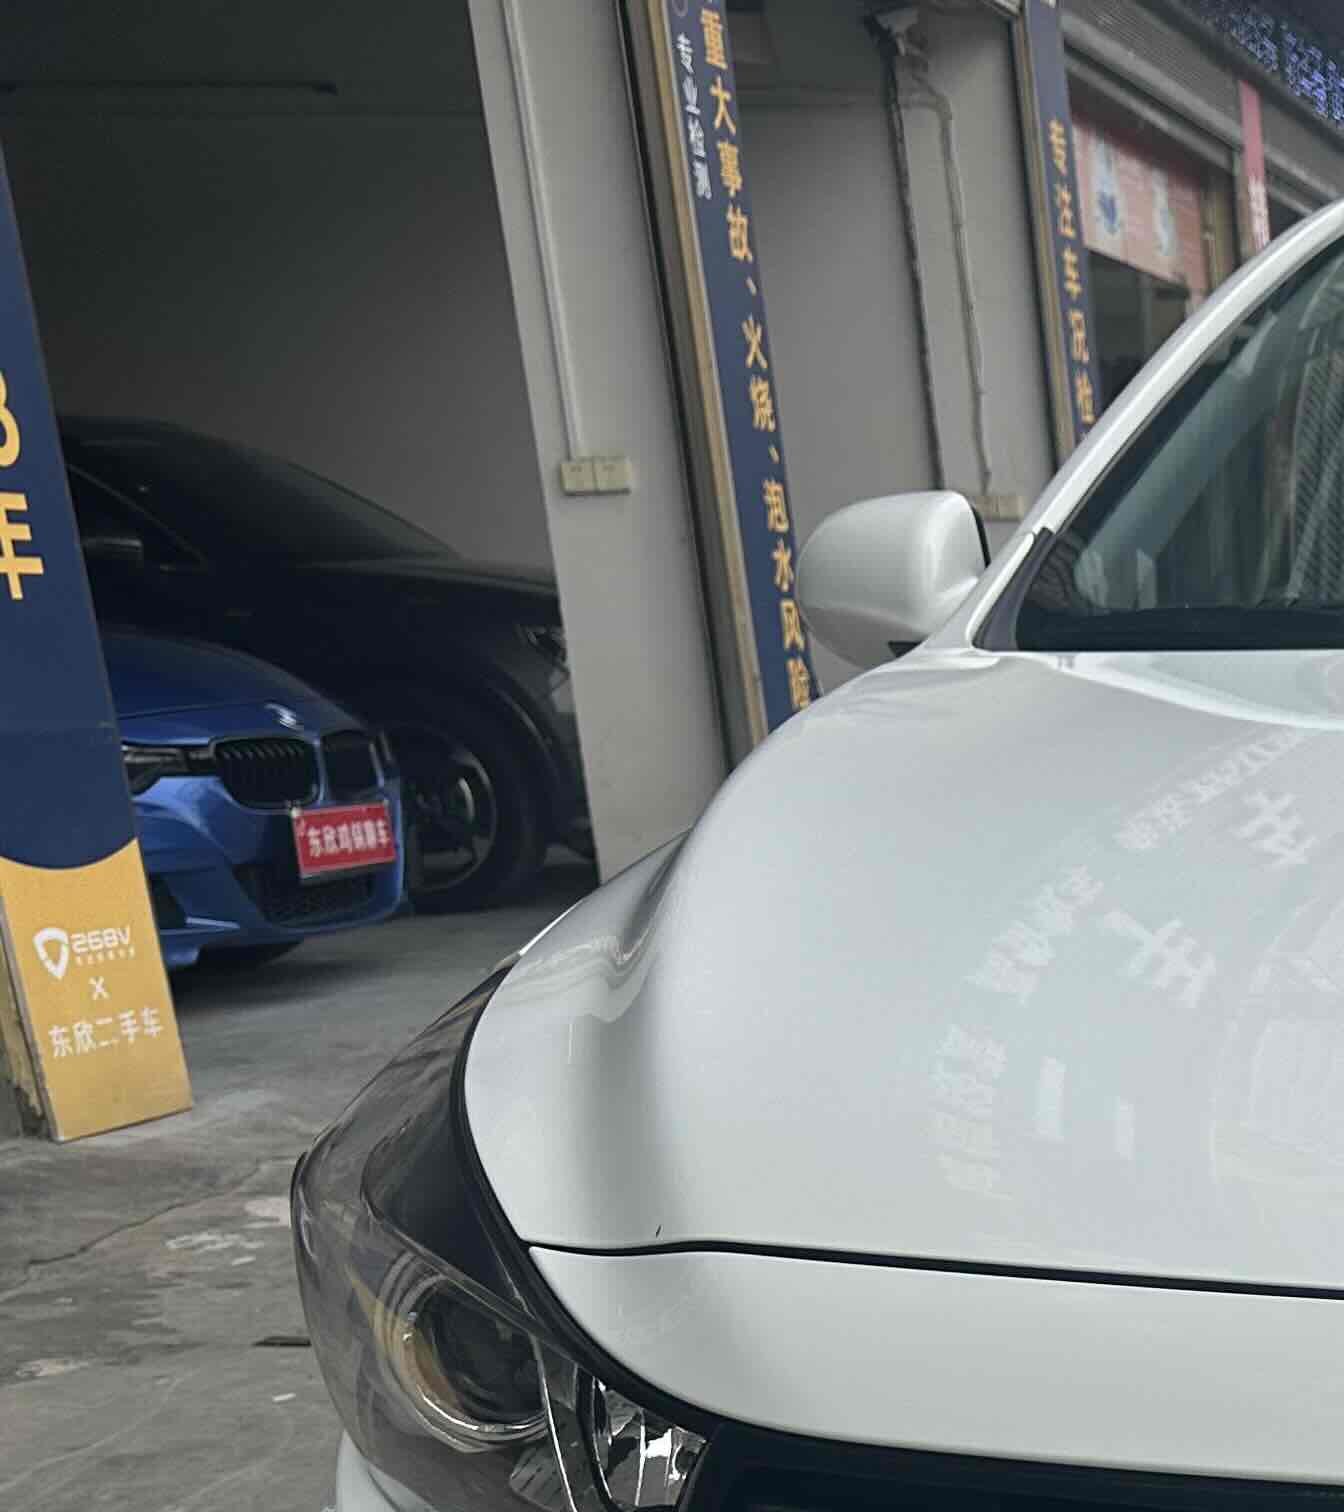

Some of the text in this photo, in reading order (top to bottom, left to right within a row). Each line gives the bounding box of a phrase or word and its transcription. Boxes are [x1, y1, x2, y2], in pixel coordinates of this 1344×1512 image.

[701, 0, 810, 709] 重大事故、火烧、泡水风险
